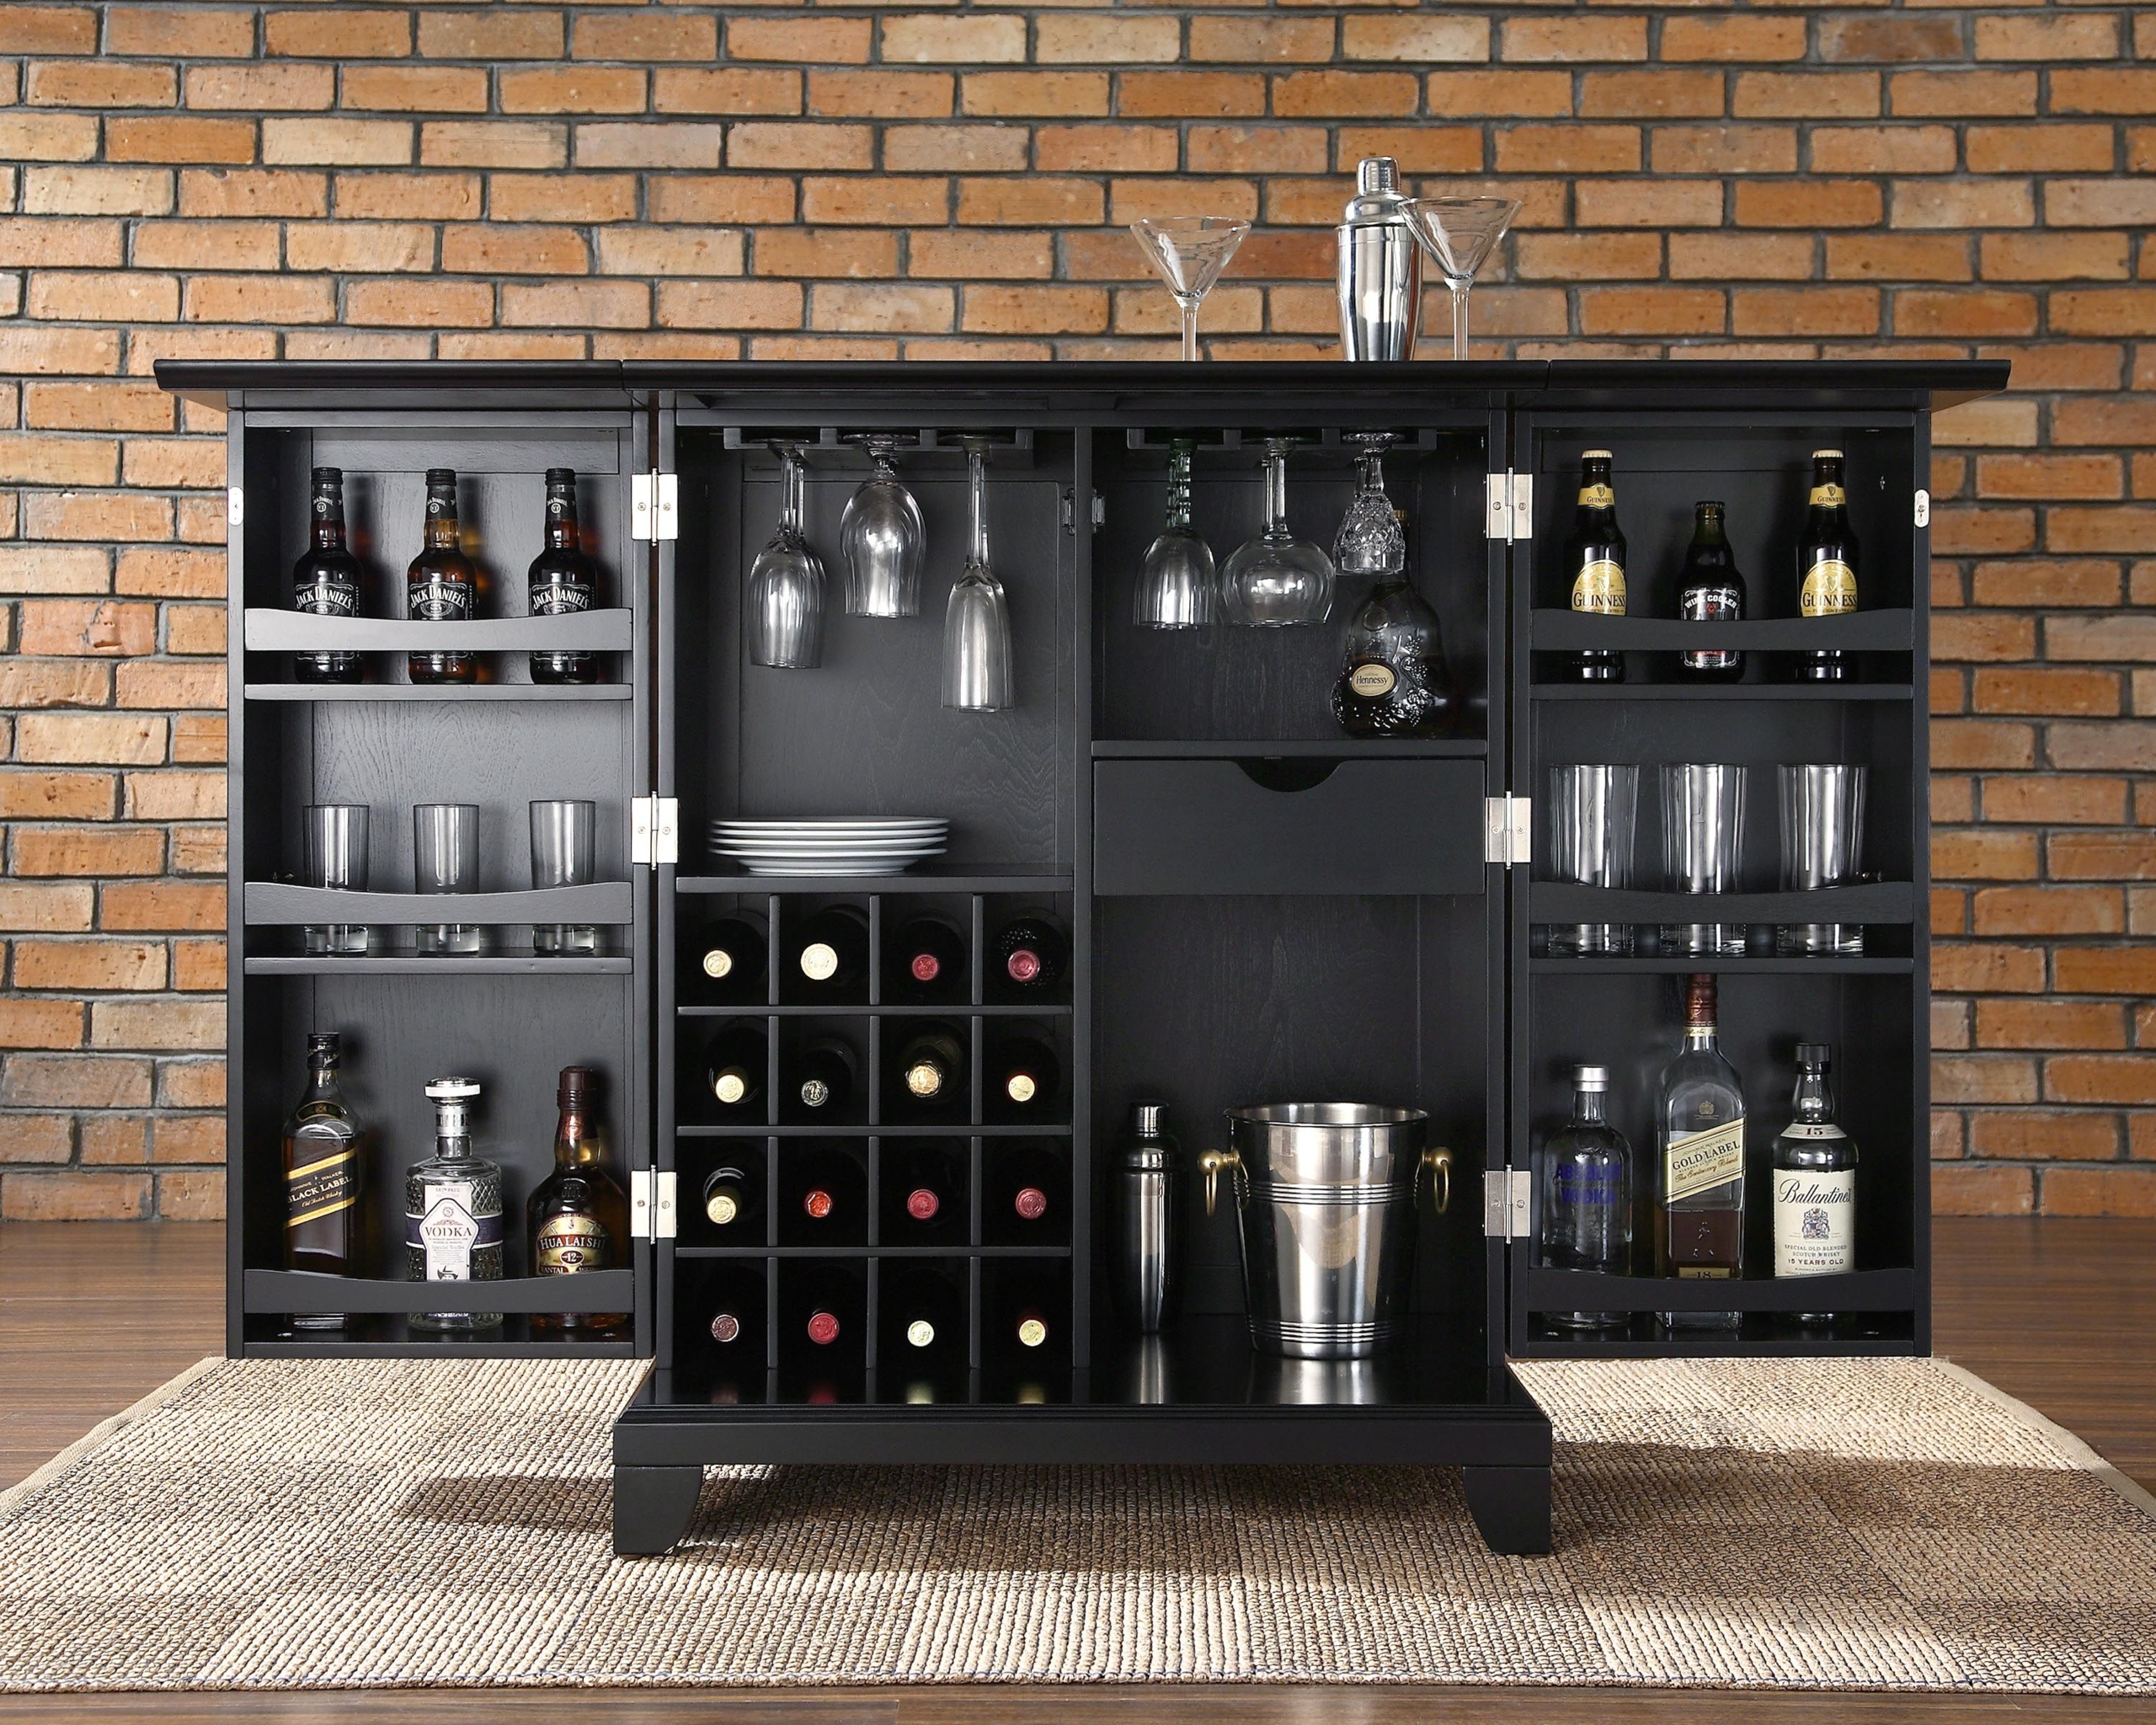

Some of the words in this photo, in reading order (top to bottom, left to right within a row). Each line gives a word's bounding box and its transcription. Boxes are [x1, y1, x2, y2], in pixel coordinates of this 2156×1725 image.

[296, 590, 315, 609] JACK
[314, 585, 353, 609] DANIEL'S
[410, 589, 429, 608] JACK
[429, 585, 467, 608] DANIEL'S
[532, 590, 552, 610] JACK
[552, 586, 590, 609] DANIEL'S
[1573, 591, 1625, 607] GUINNESS
[1684, 595, 1705, 608] WIE
[1802, 591, 1857, 607] GUINNESS
[1356, 676, 1388, 685] Hennessy
[1806, 1127, 1823, 1135] 15
[1672, 1153, 1703, 1170] GOLD
[1705, 1140, 1741, 1159] LABEL
[320, 1176, 353, 1192] LABEL
[1778, 1178, 1852, 1204] Ballantine's
[425, 1226, 472, 1236] VODKA
[567, 1252, 577, 1262] 12
